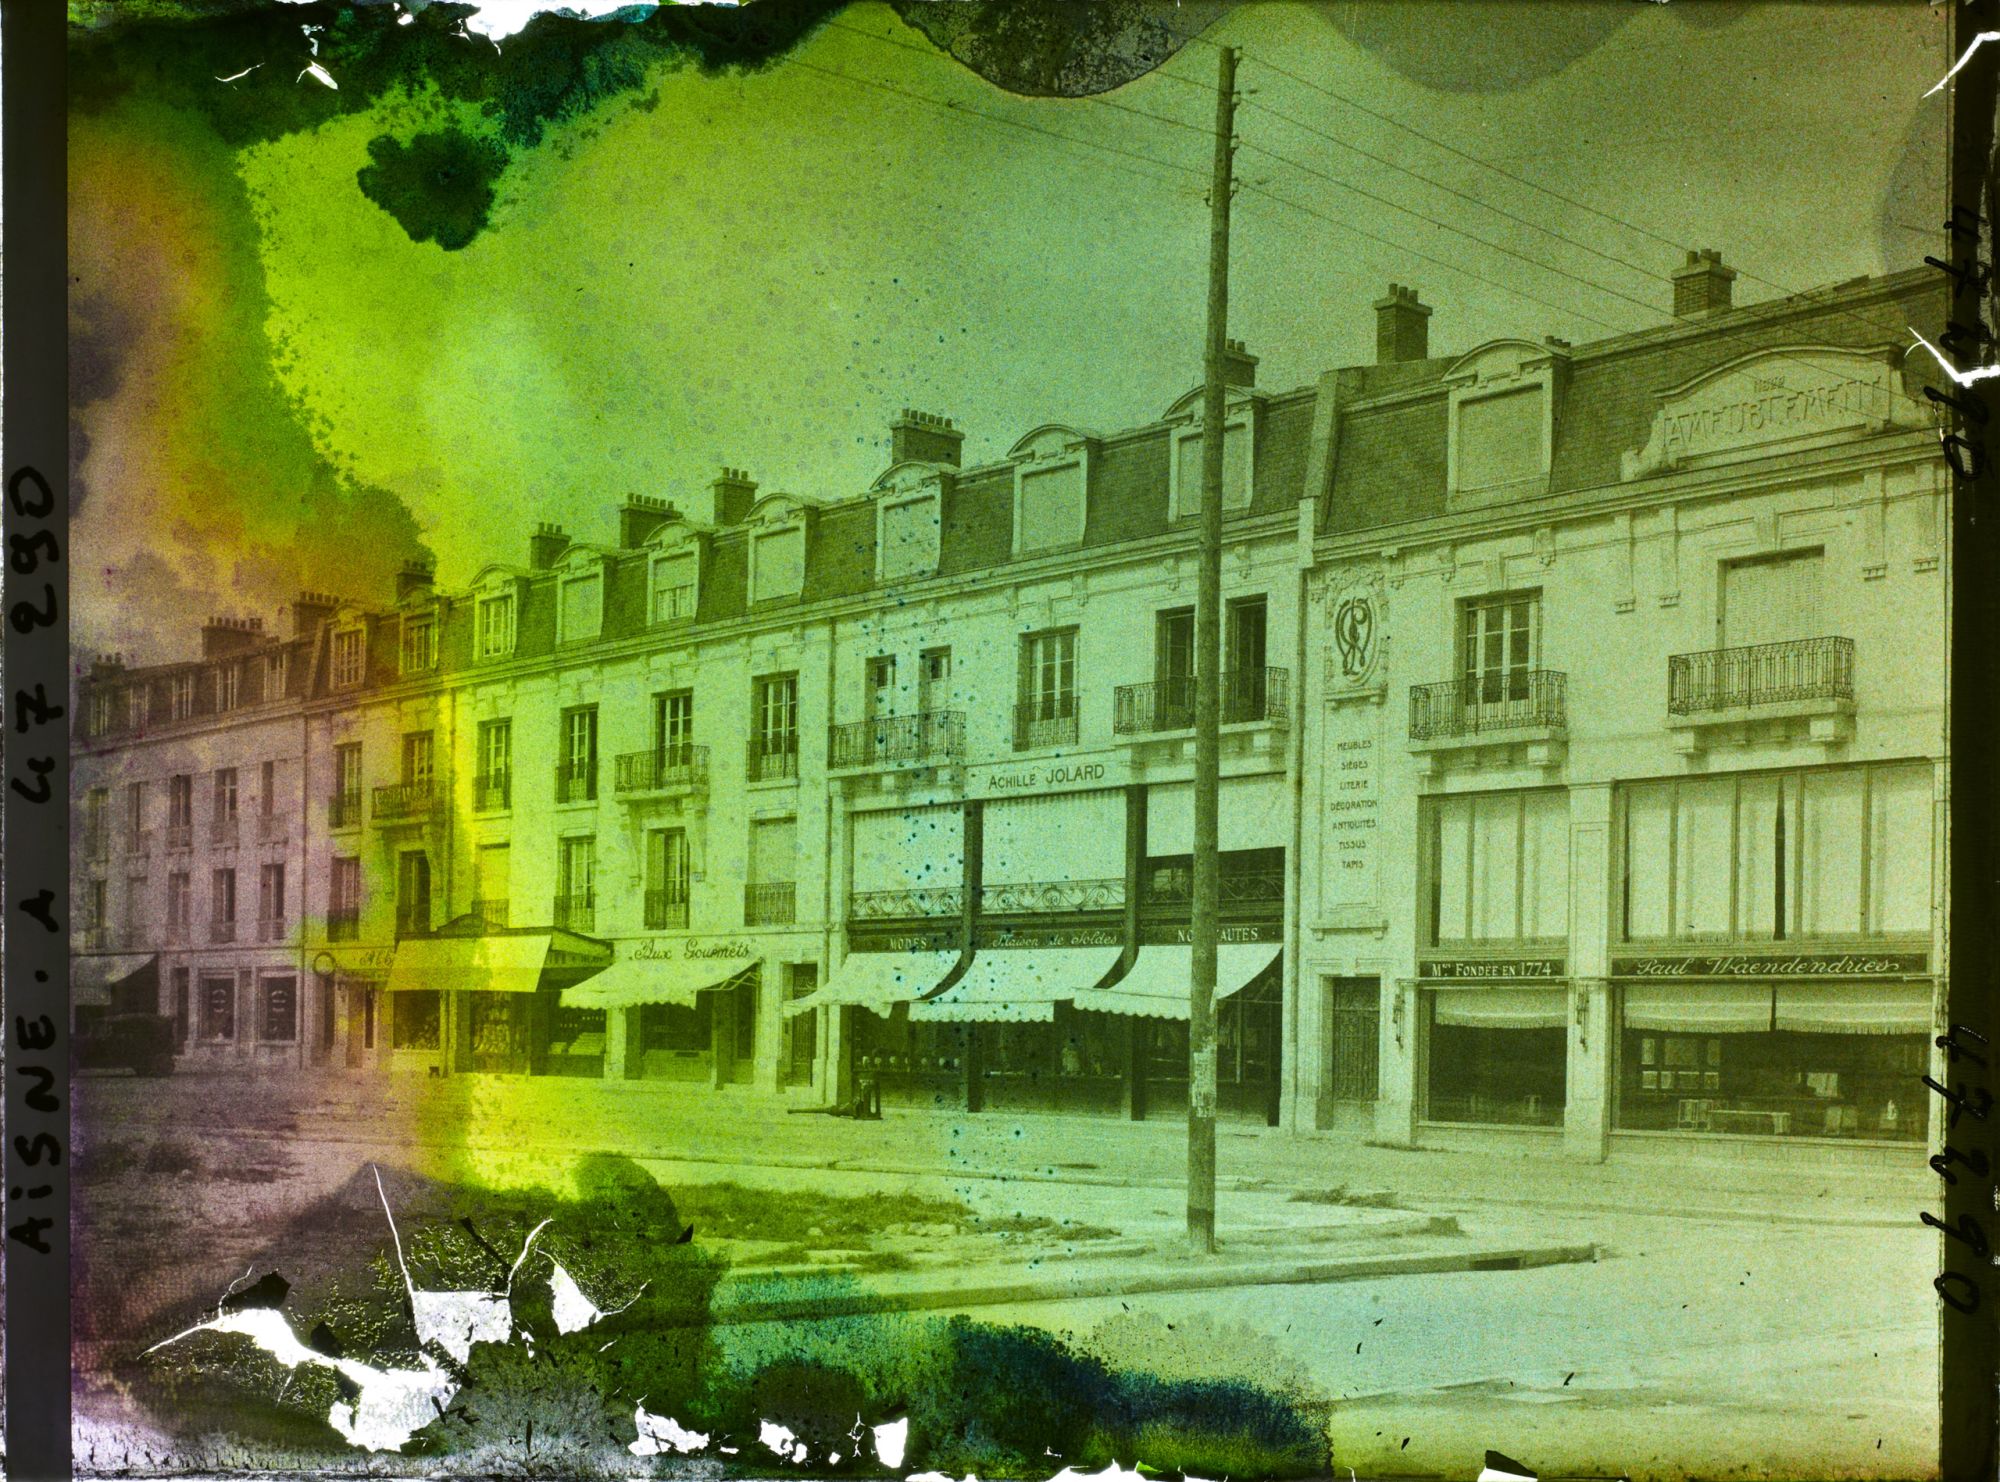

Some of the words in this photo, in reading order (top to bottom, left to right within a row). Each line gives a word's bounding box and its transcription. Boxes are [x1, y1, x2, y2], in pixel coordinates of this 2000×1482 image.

[1337, 740, 1372, 751] MEUBLES
[988, 773, 1036, 790] ACHILLE
[1045, 763, 1105, 785] JOLARD
[1340, 781, 1368, 791] LITERIE
[1339, 840, 1366, 850] TISSUS
[1342, 860, 1364, 869] TAPIS
[1051, 933, 1064, 946] de
[1071, 931, 1118, 946] Soldes
[1177, 927, 1258, 943] NOAUTES
[889, 937, 927, 951] MODES
[1502, 965, 1516, 977] EN
[1520, 961, 1552, 976] 1774
[1636, 957, 1694, 976] Paul
[1706, 955, 1900, 976] Waendendries
